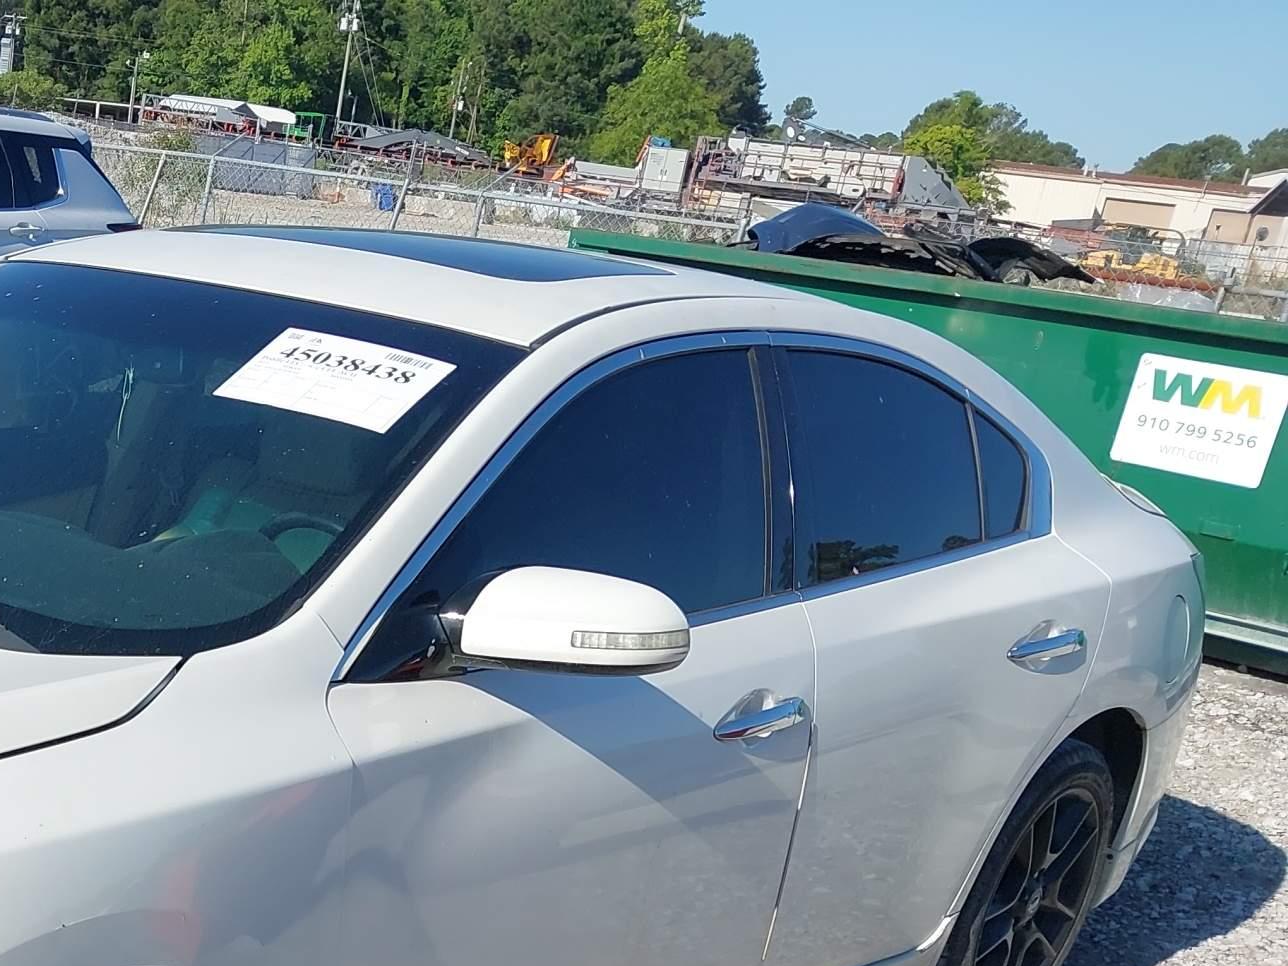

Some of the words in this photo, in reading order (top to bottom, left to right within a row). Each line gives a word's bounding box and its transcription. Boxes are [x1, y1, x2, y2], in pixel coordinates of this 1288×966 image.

[279, 346, 417, 384] 45038438
[1152, 368, 1263, 418] WM
[1137, 414, 1170, 431] 910
[1175, 421, 1207, 439] 799
[1211, 429, 1258, 449] 5256
[1159, 444, 1220, 465] wm.com
